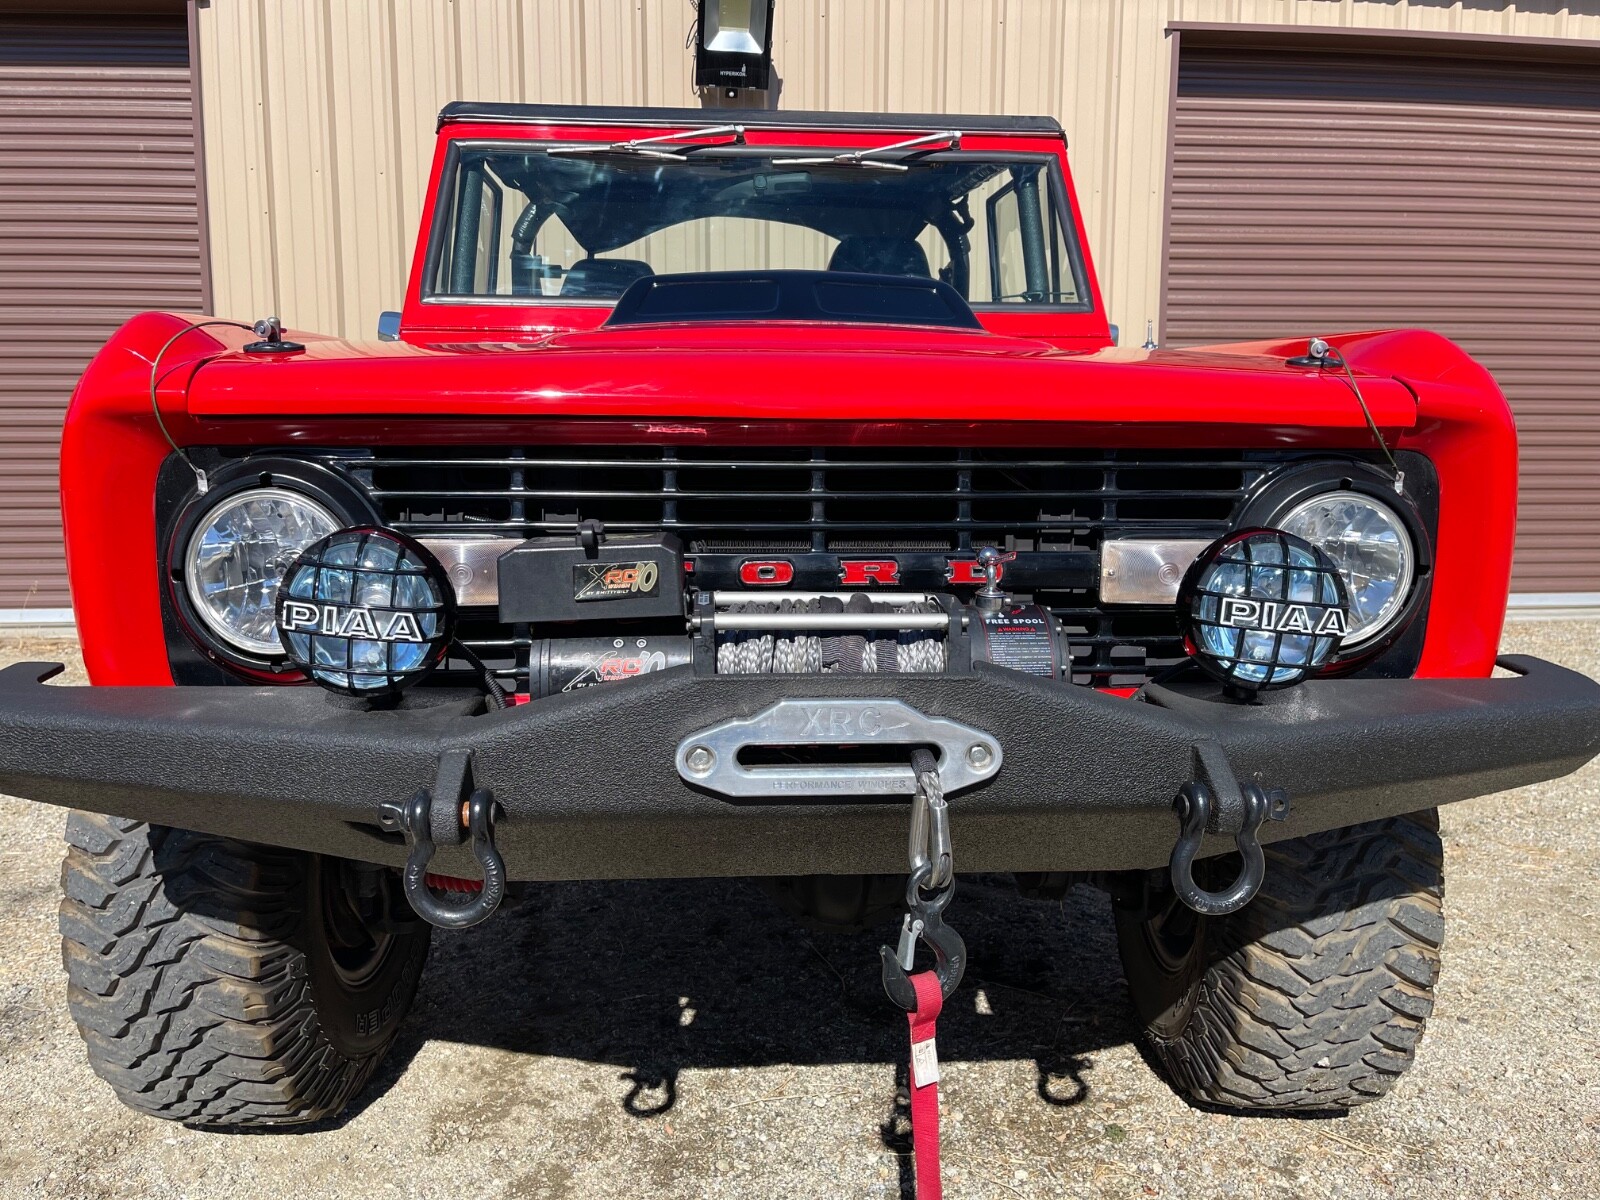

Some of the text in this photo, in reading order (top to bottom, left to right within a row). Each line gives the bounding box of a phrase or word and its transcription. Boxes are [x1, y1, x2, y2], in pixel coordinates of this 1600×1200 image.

[282, 600, 424, 642] PIAA
[1219, 597, 1348, 637] PIAA
[800, 706, 882, 737] XRC
[772, 779, 907, 790] PERFORMANCE WINCHES
